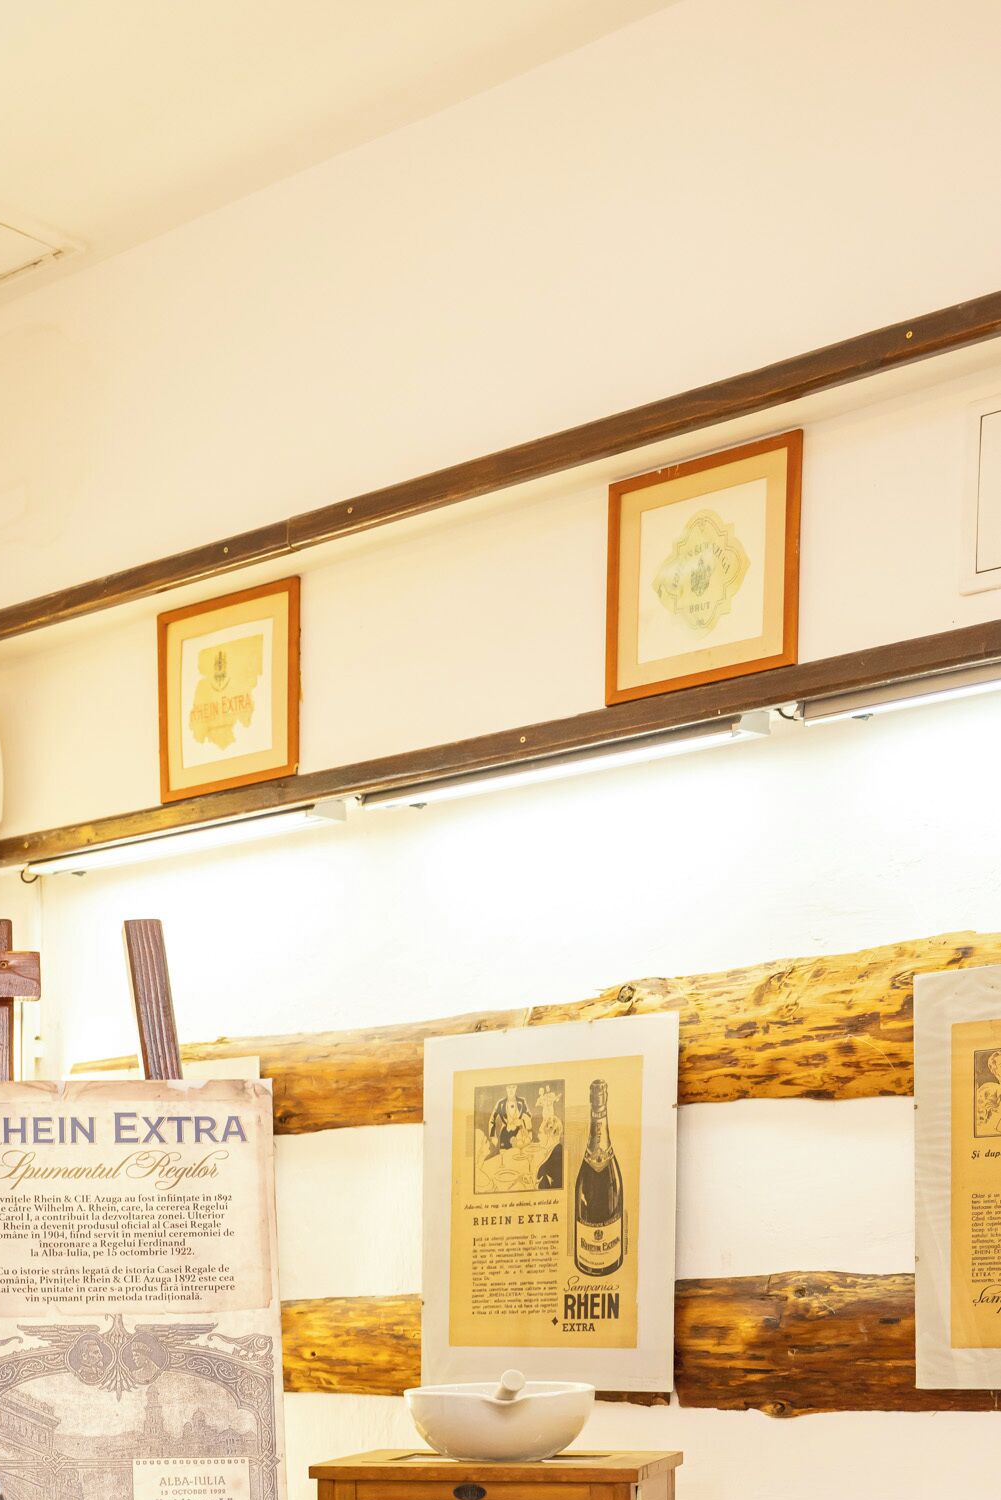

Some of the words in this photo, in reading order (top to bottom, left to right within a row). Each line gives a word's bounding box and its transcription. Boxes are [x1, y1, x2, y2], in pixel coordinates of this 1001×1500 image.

[114, 1112, 250, 1144] EXTRA
[126, 1150, 229, 1190] Regilor
[94, 1194, 122, 1204] Azuga
[88, 1203, 118, 1213] Rhein,
[192, 1202, 228, 1212] Regelui
[473, 1216, 512, 1226] RHEIN
[518, 1213, 558, 1224] EXTRA
[77, 1221, 118, 1231] produsul
[190, 1220, 221, 1230] Regale
[100, 1239, 135, 1249] Regelui
[41, 1249, 90, 1258] Alba-Iulia,
[184, 1265, 216, 1275] Regale
[143, 1275, 171, 1284] Azuga
[125, 1284, 158, 1293] produs
[42, 1294, 82, 1304] spumant
[85, 1294, 104, 1303] prin
[564, 1293, 619, 1320] RHEIN
[563, 1322, 595, 1332] EXTRA
[160, 1476, 226, 1486] ALBA-IULIA
